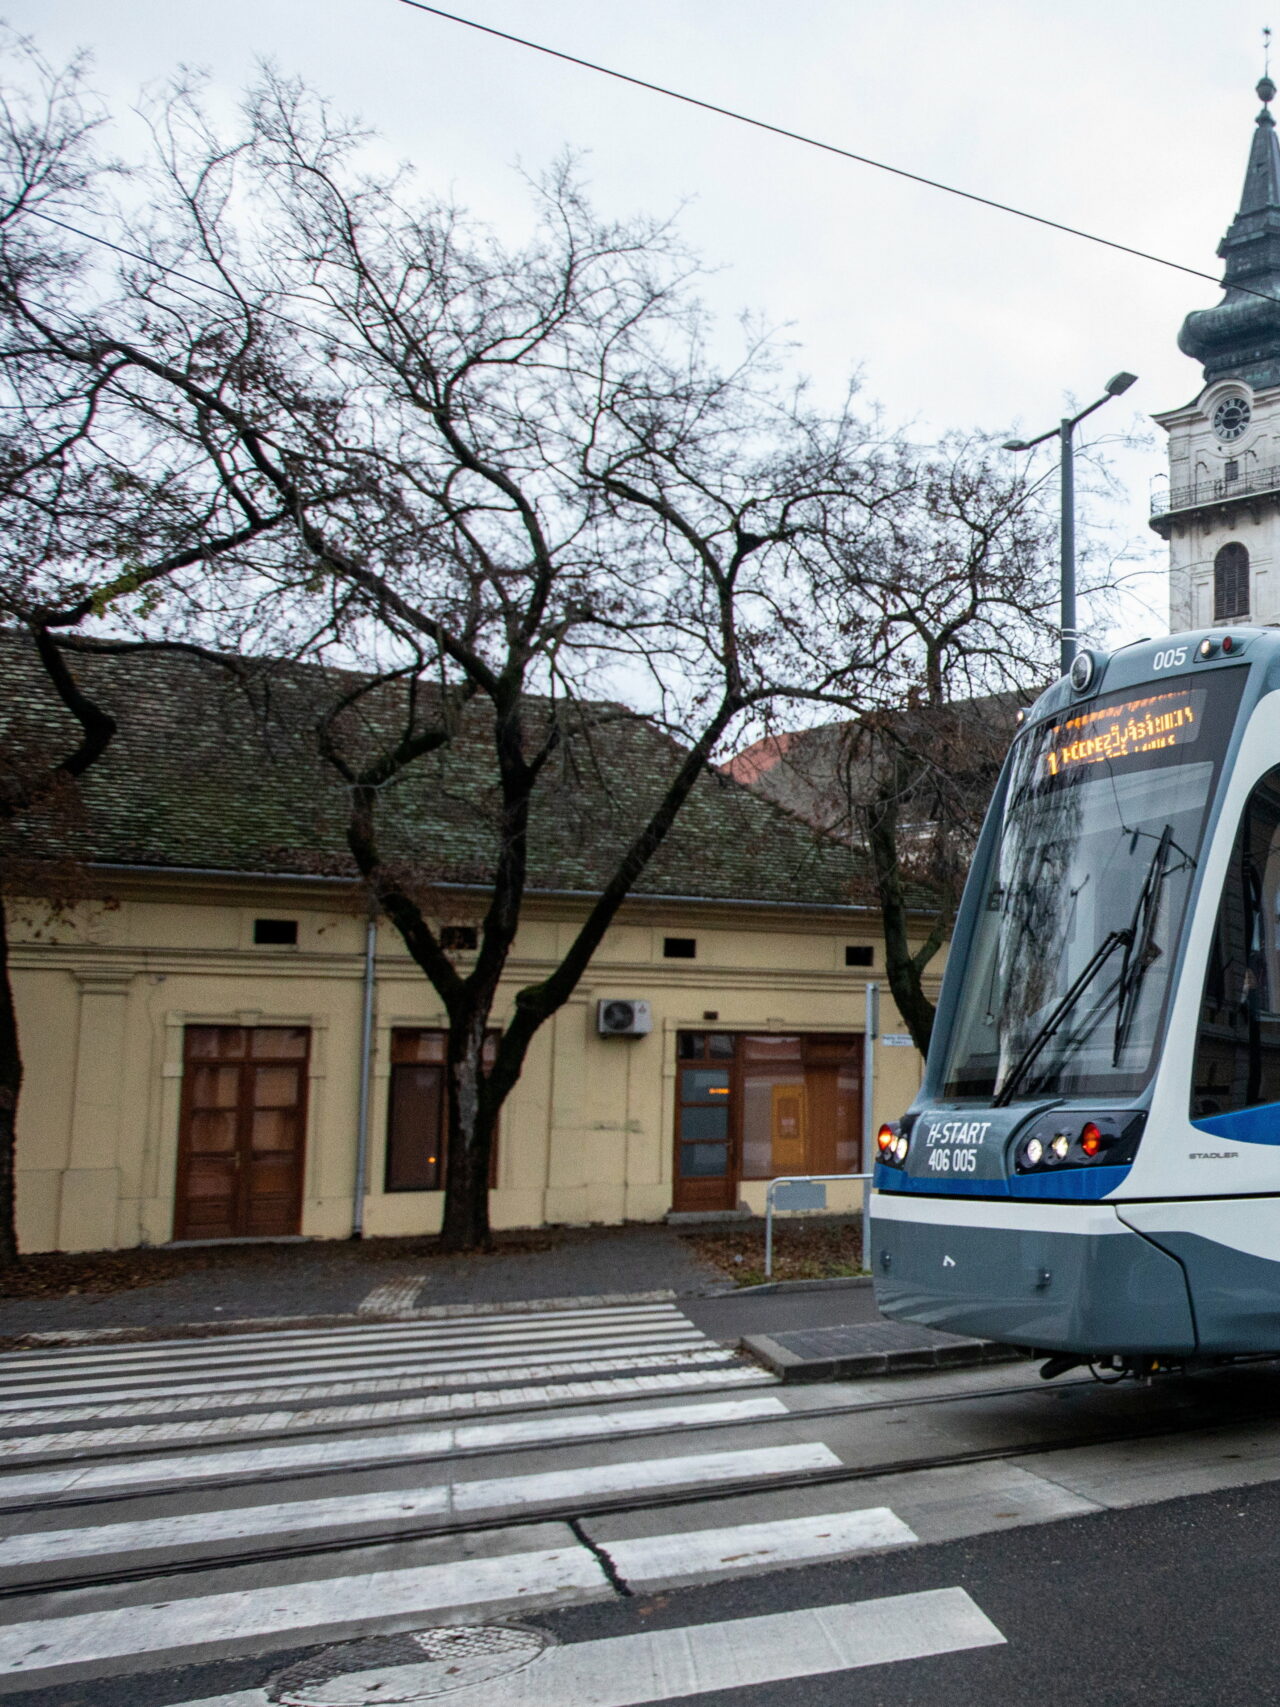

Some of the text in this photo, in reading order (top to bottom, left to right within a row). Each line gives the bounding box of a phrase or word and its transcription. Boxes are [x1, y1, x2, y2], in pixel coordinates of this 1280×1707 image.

[1153, 646, 1188, 671] 005
[926, 1122, 992, 1146] H-START
[928, 1148, 978, 1172] 406 005
[1189, 1152, 1239, 1160] STADLER
